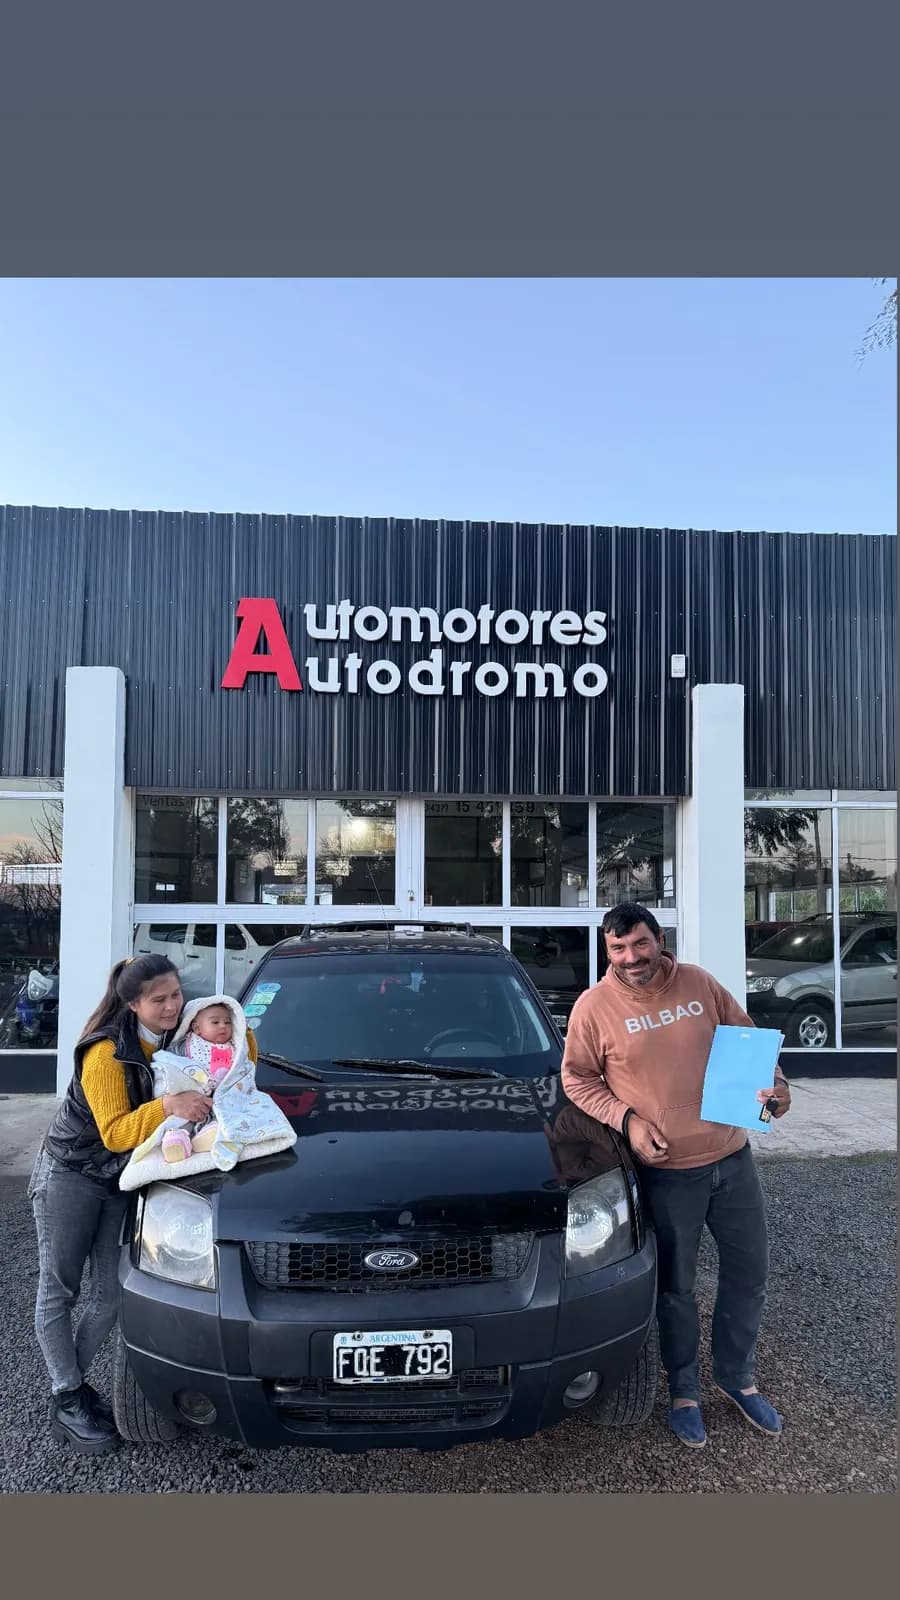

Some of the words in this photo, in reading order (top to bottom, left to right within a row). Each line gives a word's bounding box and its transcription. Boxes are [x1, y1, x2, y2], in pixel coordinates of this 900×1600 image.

[625, 1001, 704, 1034] BILBAO
[378, 1253, 406, 1266] Ford
[369, 1333, 417, 1343] ARGENTINA
[338, 1346, 385, 1378] FQE
[401, 1344, 448, 1375] 792
